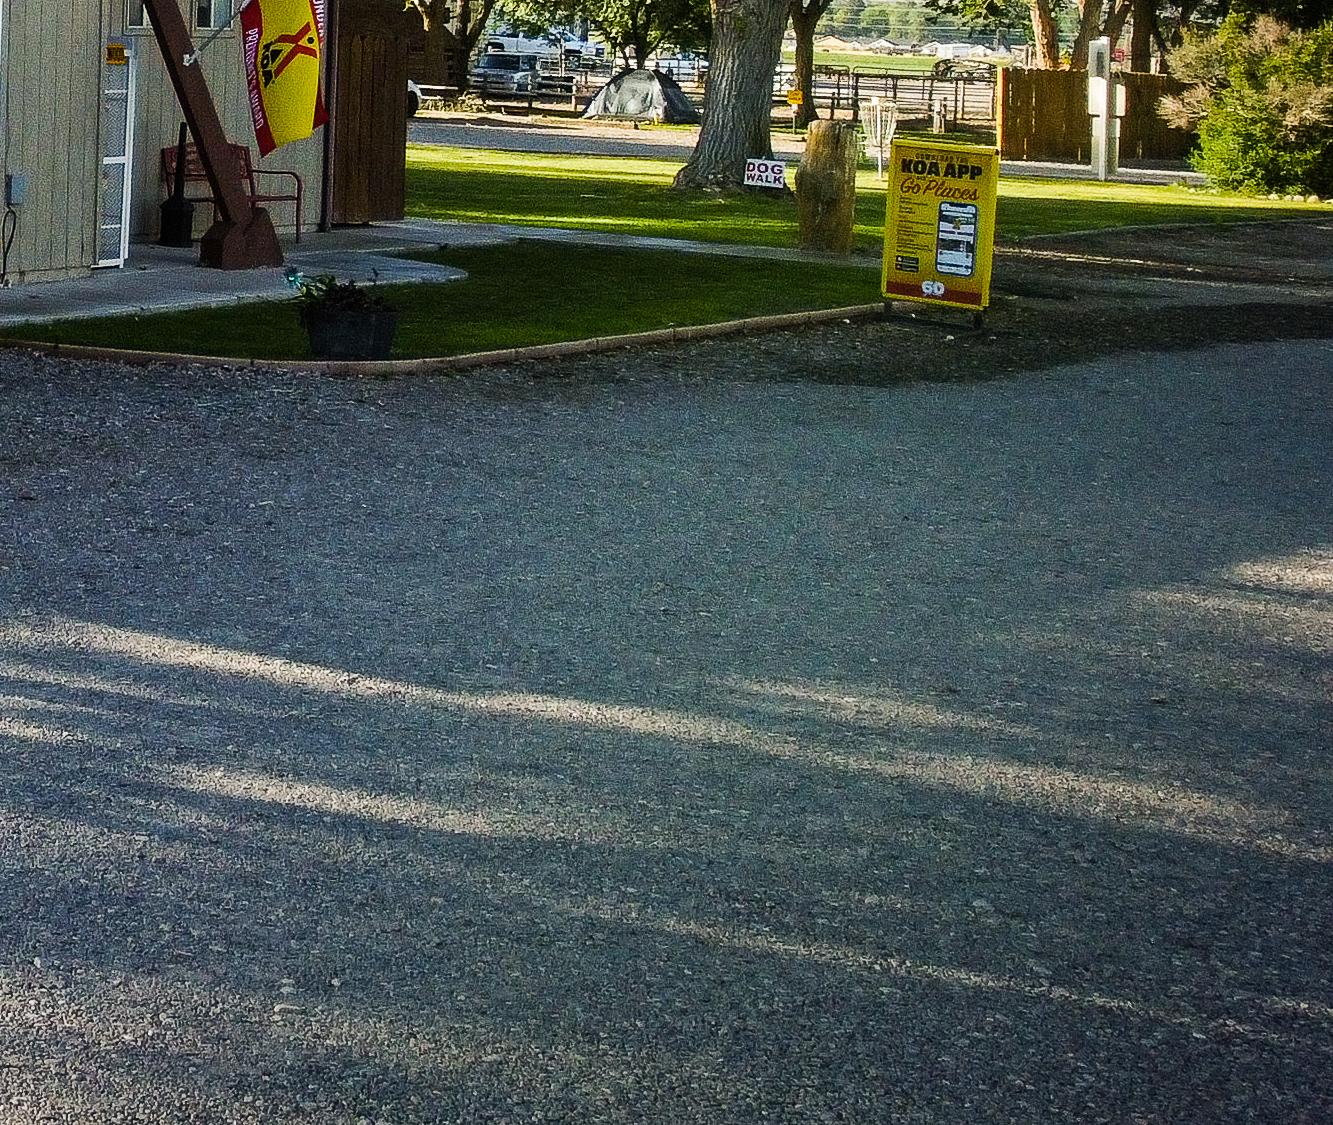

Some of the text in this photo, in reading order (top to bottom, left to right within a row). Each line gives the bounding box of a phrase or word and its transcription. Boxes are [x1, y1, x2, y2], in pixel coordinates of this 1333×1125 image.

[261, 40, 274, 88] KOA
[746, 162, 783, 175] DOG
[901, 158, 983, 180] KOA APP
[746, 173, 782, 184] WALK
[900, 177, 980, 201] Go Places
[922, 280, 945, 296] 60
